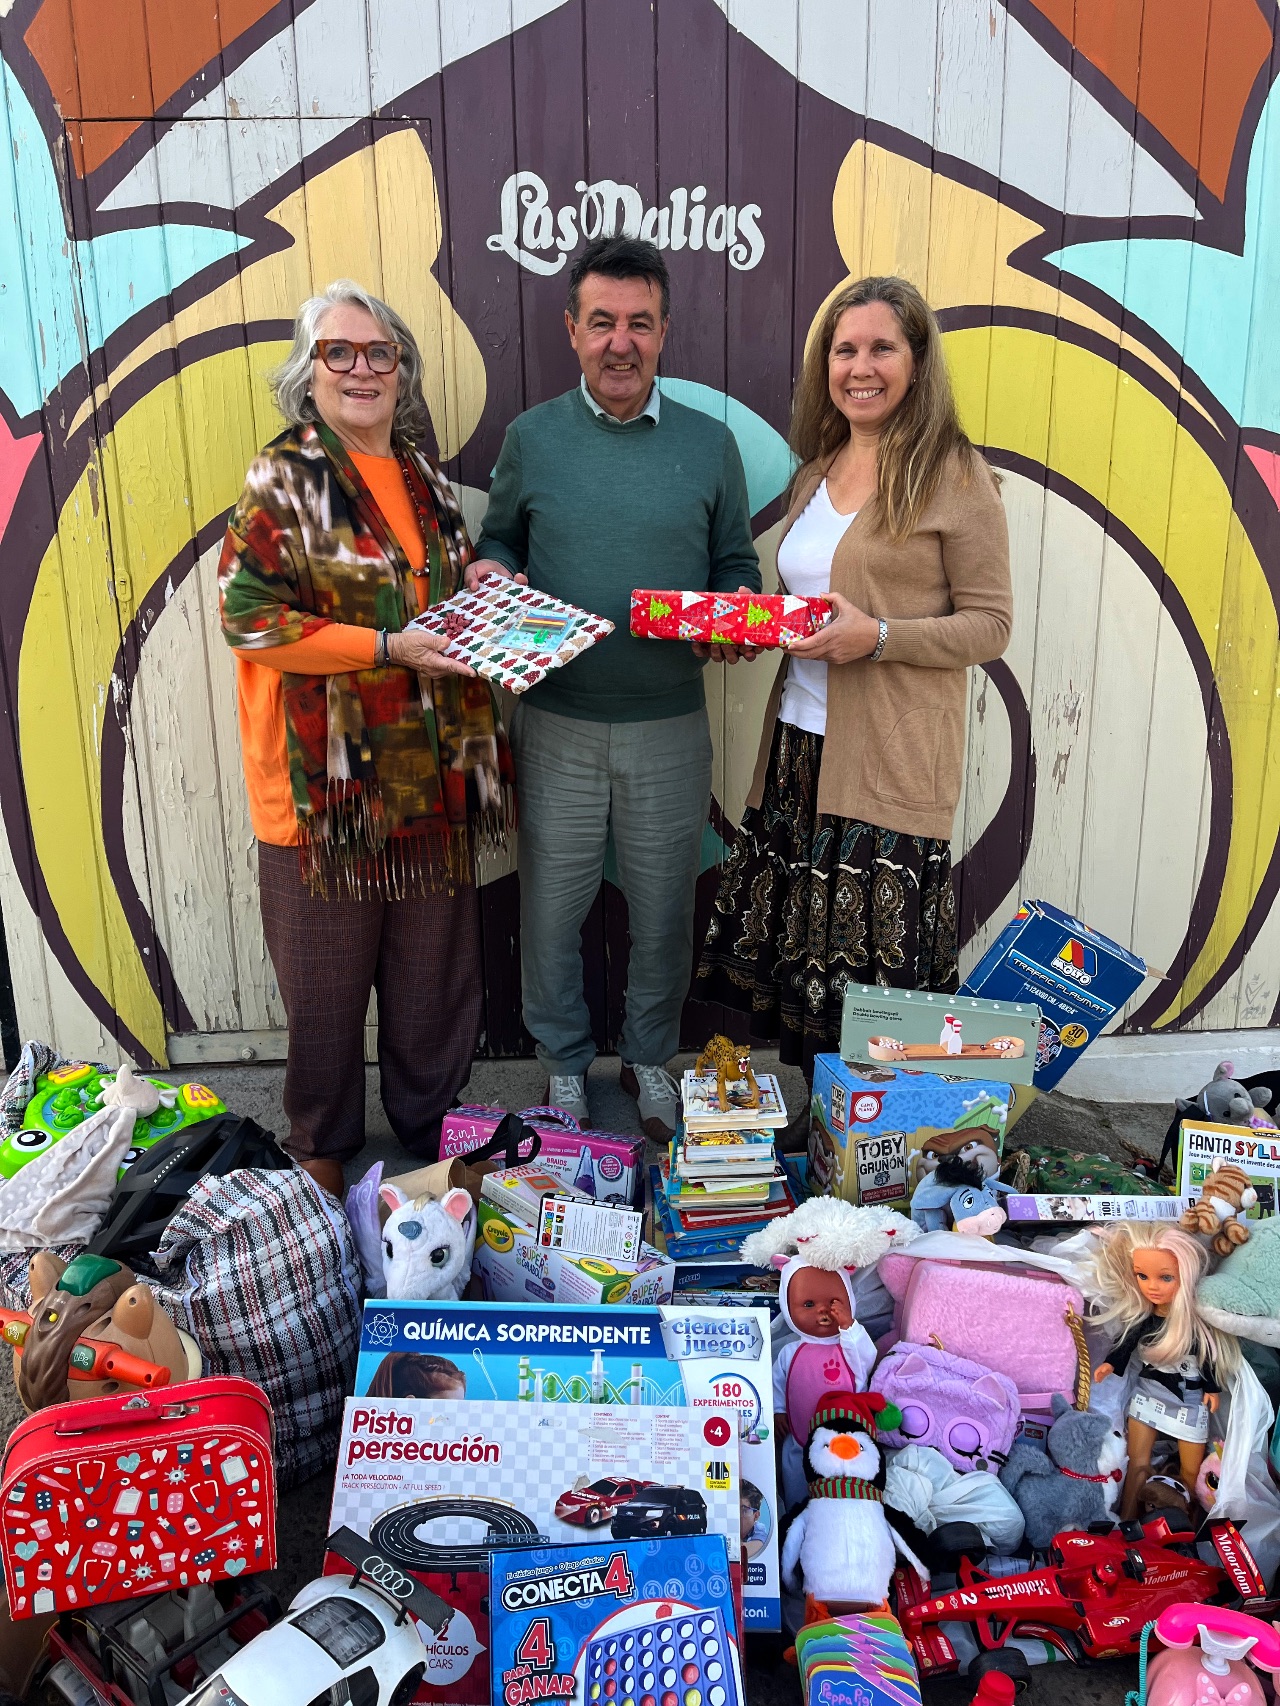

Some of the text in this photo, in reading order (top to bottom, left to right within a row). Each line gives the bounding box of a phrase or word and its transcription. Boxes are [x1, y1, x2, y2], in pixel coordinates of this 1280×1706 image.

[486, 171, 766, 276] Las Dalias
[1052, 957, 1092, 986] MOLTO
[1013, 958, 1108, 1014] TRAFFIC PLAYMAT
[1068, 1025, 1085, 1039] 30
[832, 1085, 845, 1102] TOBY
[446, 1128, 458, 1141] 2
[470, 1125, 478, 1136] 1
[857, 1136, 904, 1161] TOBY
[1189, 1133, 1232, 1154] FANTA
[546, 1157, 568, 1167] BRAIDS
[859, 1153, 905, 1176] GRUÑÓN
[493, 1165, 529, 1179] GAME
[1101, 1201, 1112, 1217] 100
[487, 1225, 509, 1238] Crayola
[403, 1318, 651, 1345] QUÍMICA SORPRENDENTE
[671, 1318, 751, 1336] ciencia
[681, 1335, 746, 1356] juego
[712, 1383, 742, 1398] 180
[693, 1399, 754, 1408] EXPERIMENTOS
[352, 1409, 413, 1435] Pista
[709, 1426, 723, 1438] +4
[347, 1436, 500, 1466] persecución
[1215, 1533, 1252, 1595] Motordom
[1141, 1569, 1189, 1586] Motordom
[505, 1571, 605, 1608] CONECTA
[960, 1592, 978, 1606] 2
[426, 1641, 469, 1656] HÍCULOS
[521, 1622, 551, 1666] 4
[428, 1658, 454, 1670] CARS
[503, 1665, 532, 1682] PARA
[505, 1675, 575, 1704] GANAR
[822, 1682, 853, 1706] Peppa
[854, 1688, 870, 1706] Pig
